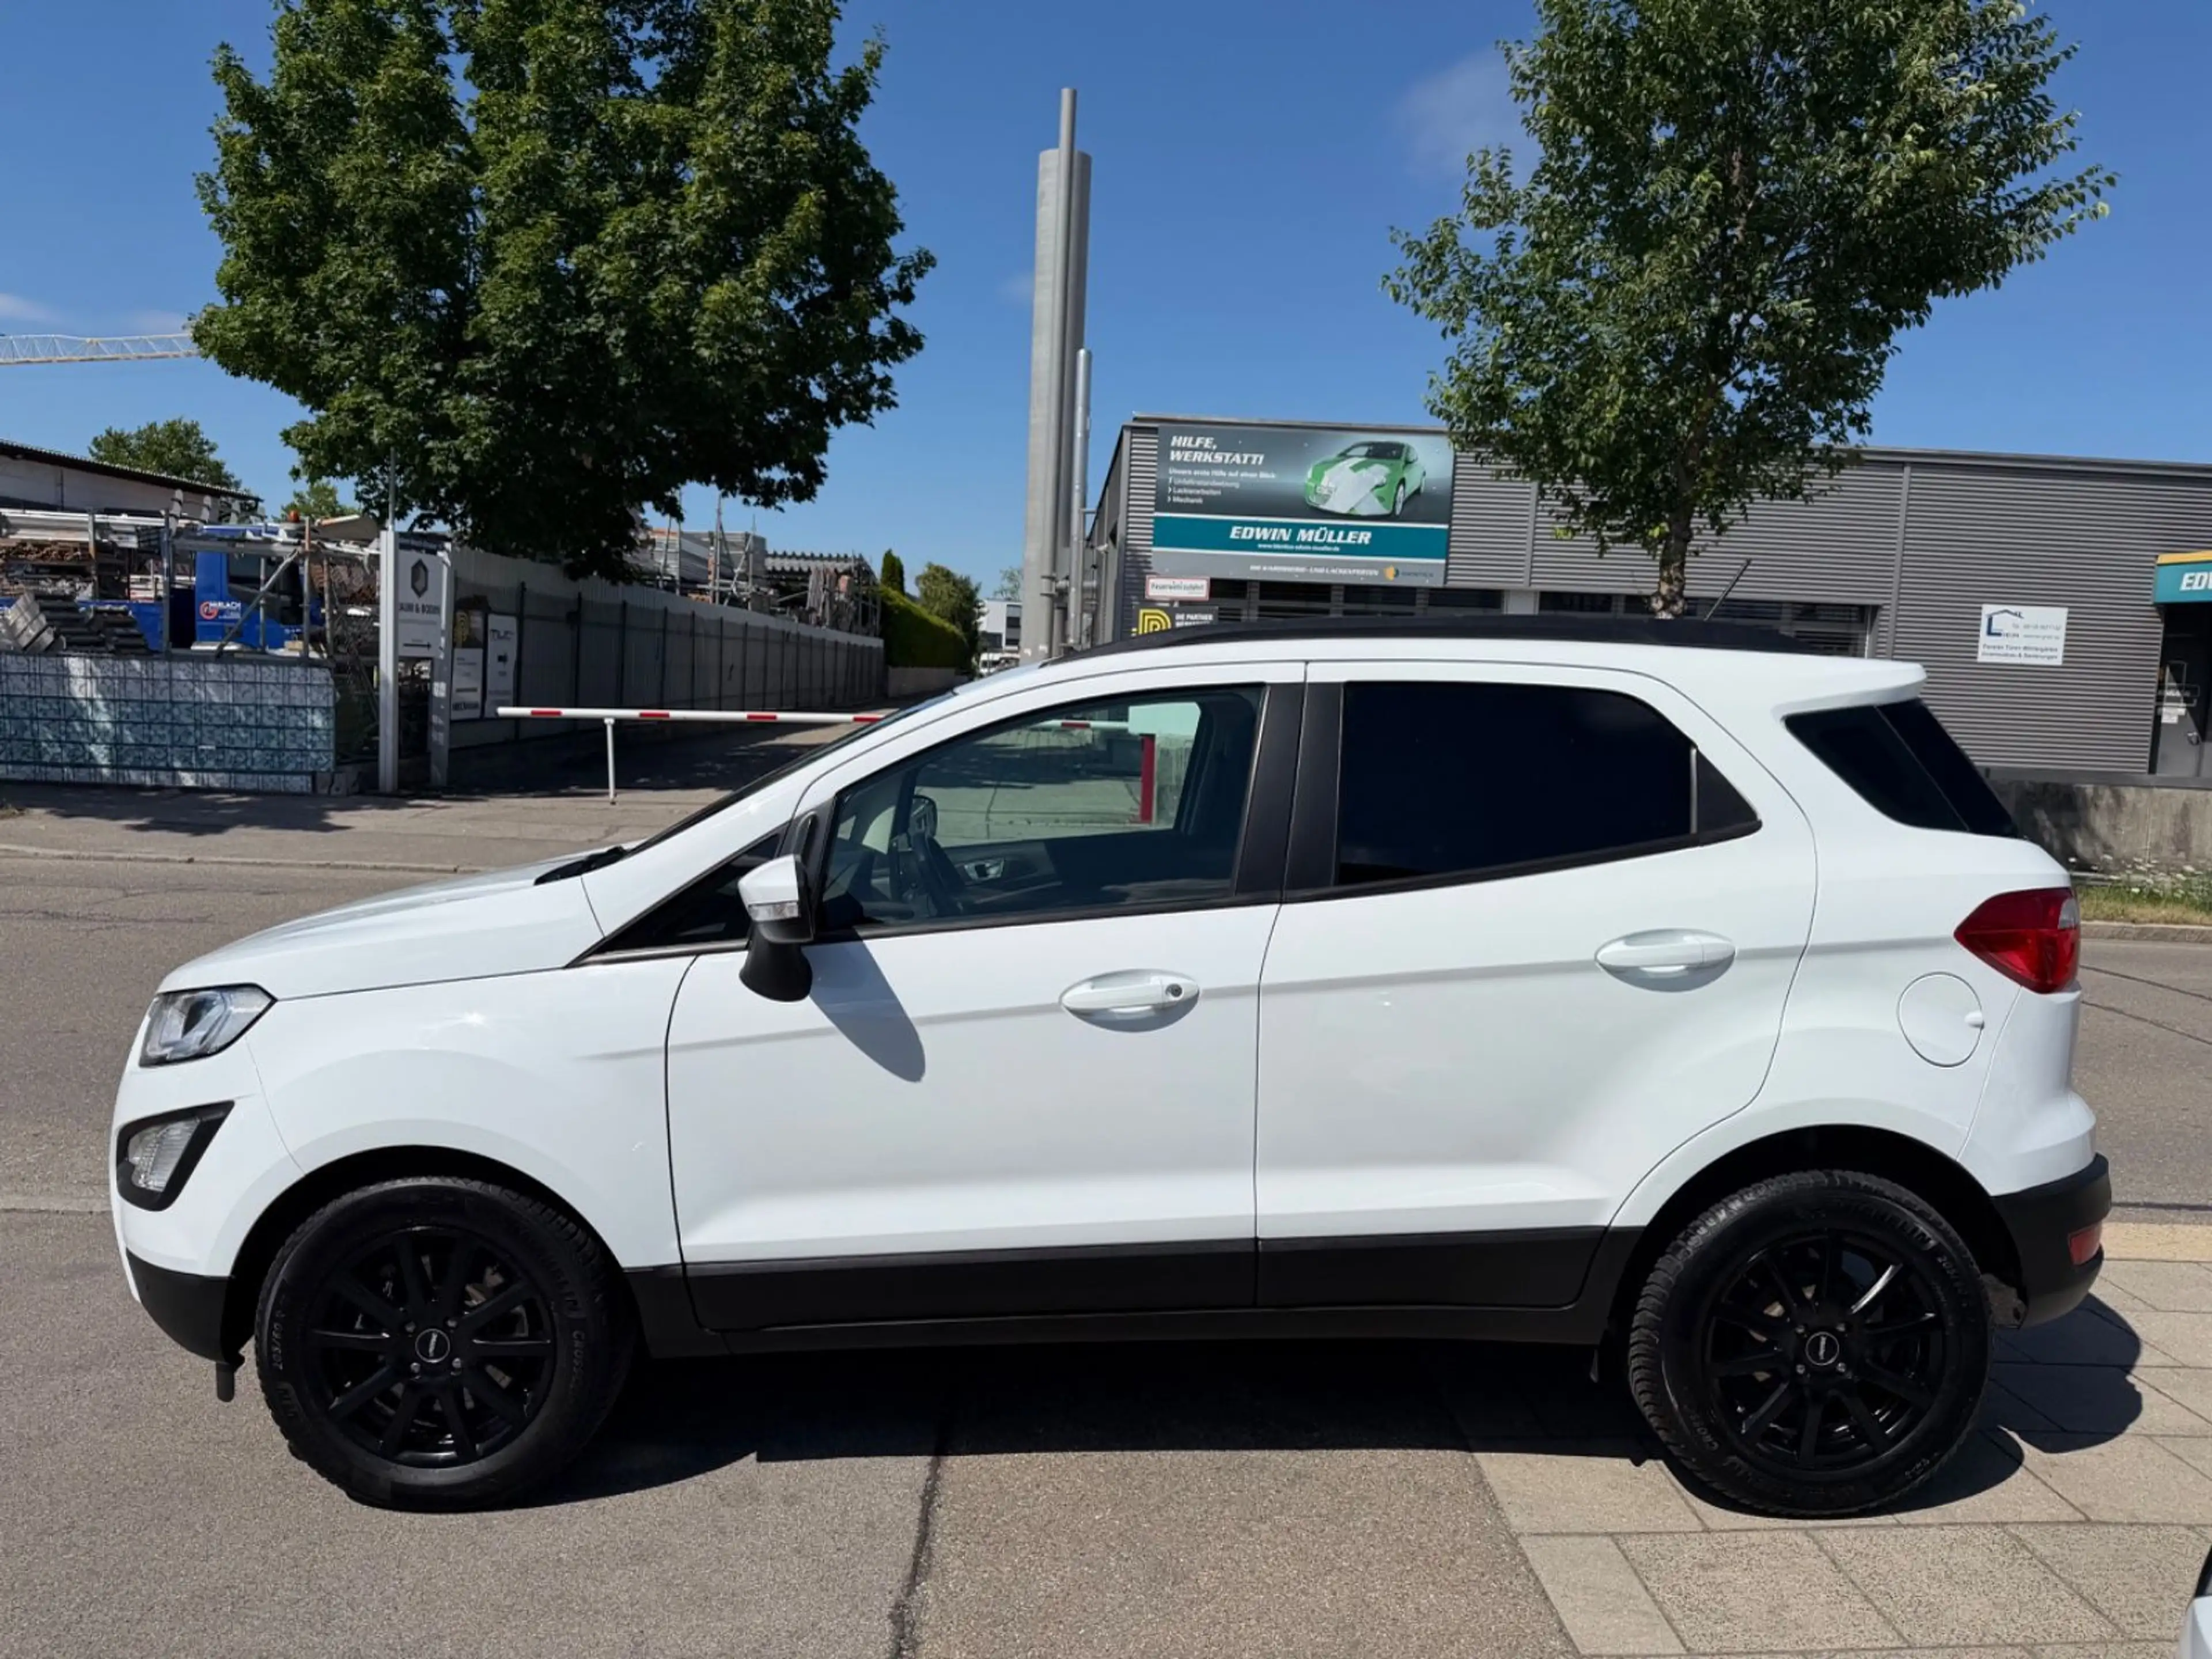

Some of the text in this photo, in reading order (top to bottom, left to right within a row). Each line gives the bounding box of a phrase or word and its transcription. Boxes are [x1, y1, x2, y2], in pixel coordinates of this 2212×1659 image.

[1171, 435, 1217, 450] HILFE,
[1229, 525, 1373, 545] EDWIN MÜLLER
